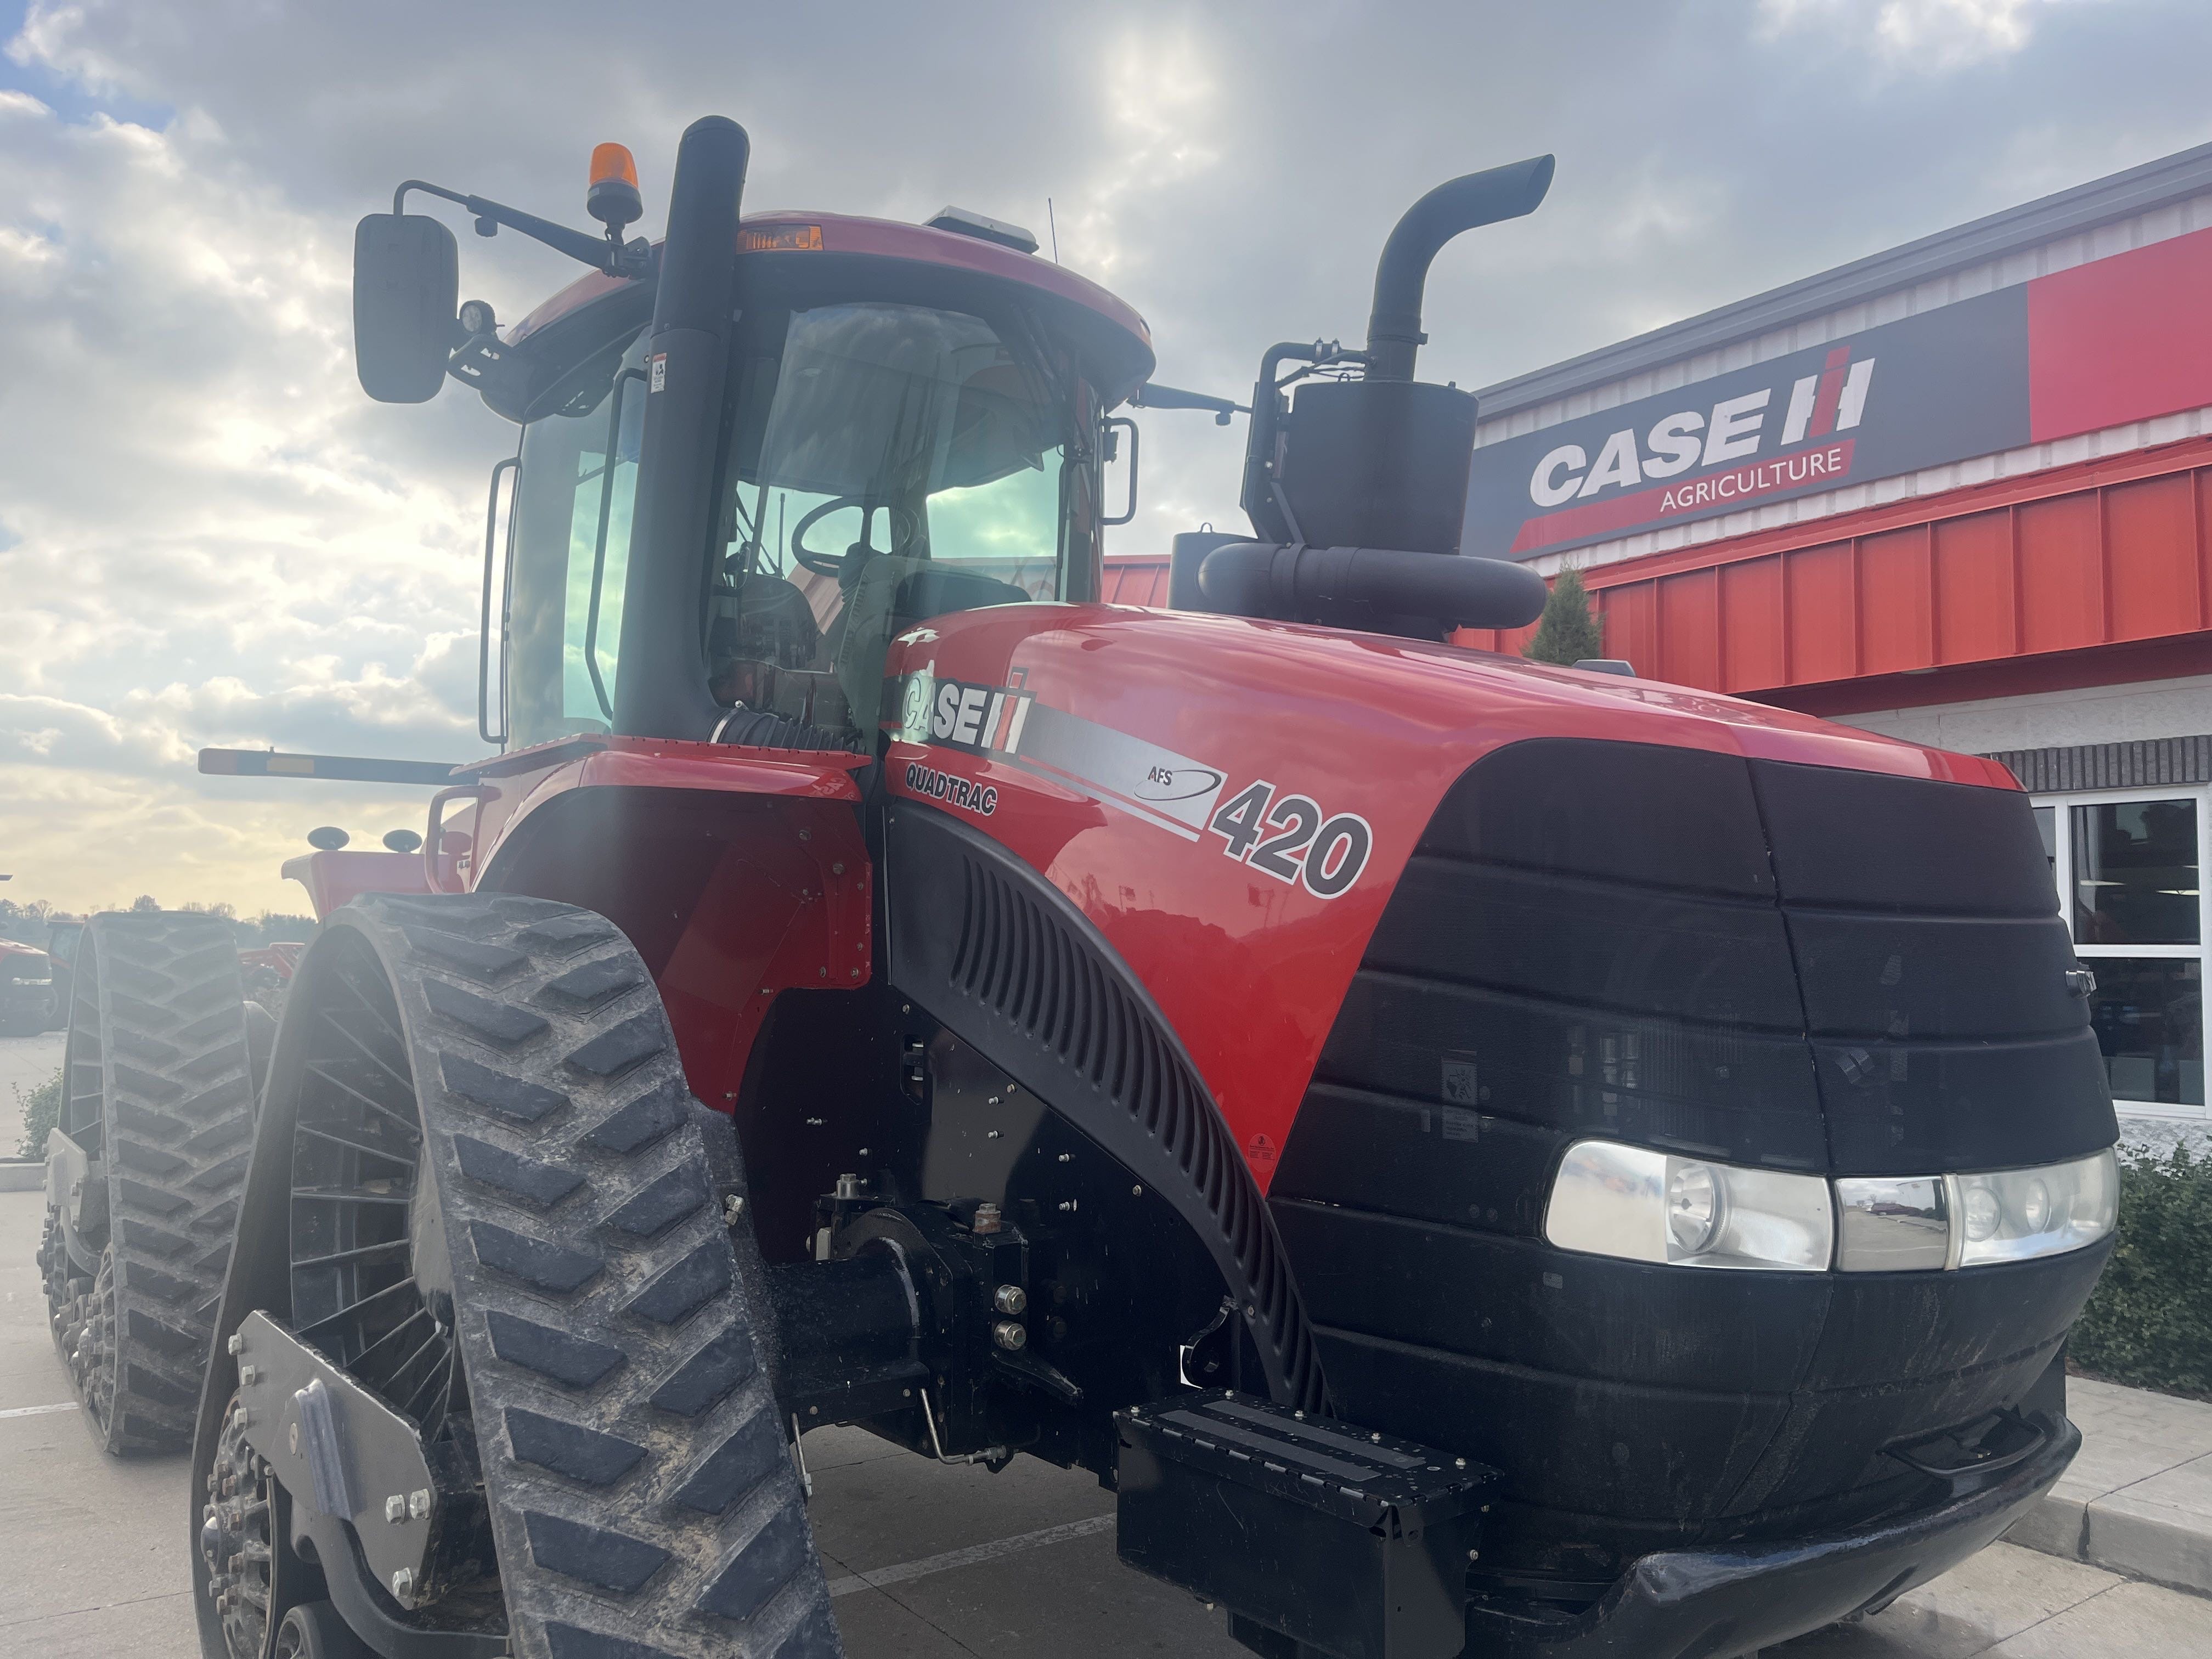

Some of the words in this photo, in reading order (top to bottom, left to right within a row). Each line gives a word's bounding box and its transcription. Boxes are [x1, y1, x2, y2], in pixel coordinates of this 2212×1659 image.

[1529, 387, 1771, 507] CASE
[1660, 447, 1842, 512] AGRICULTURE
[902, 674, 988, 746] CASE
[905, 761, 998, 817] QUADTRAC
[1148, 766, 1172, 786] AFS
[1209, 779, 1373, 900] 420
